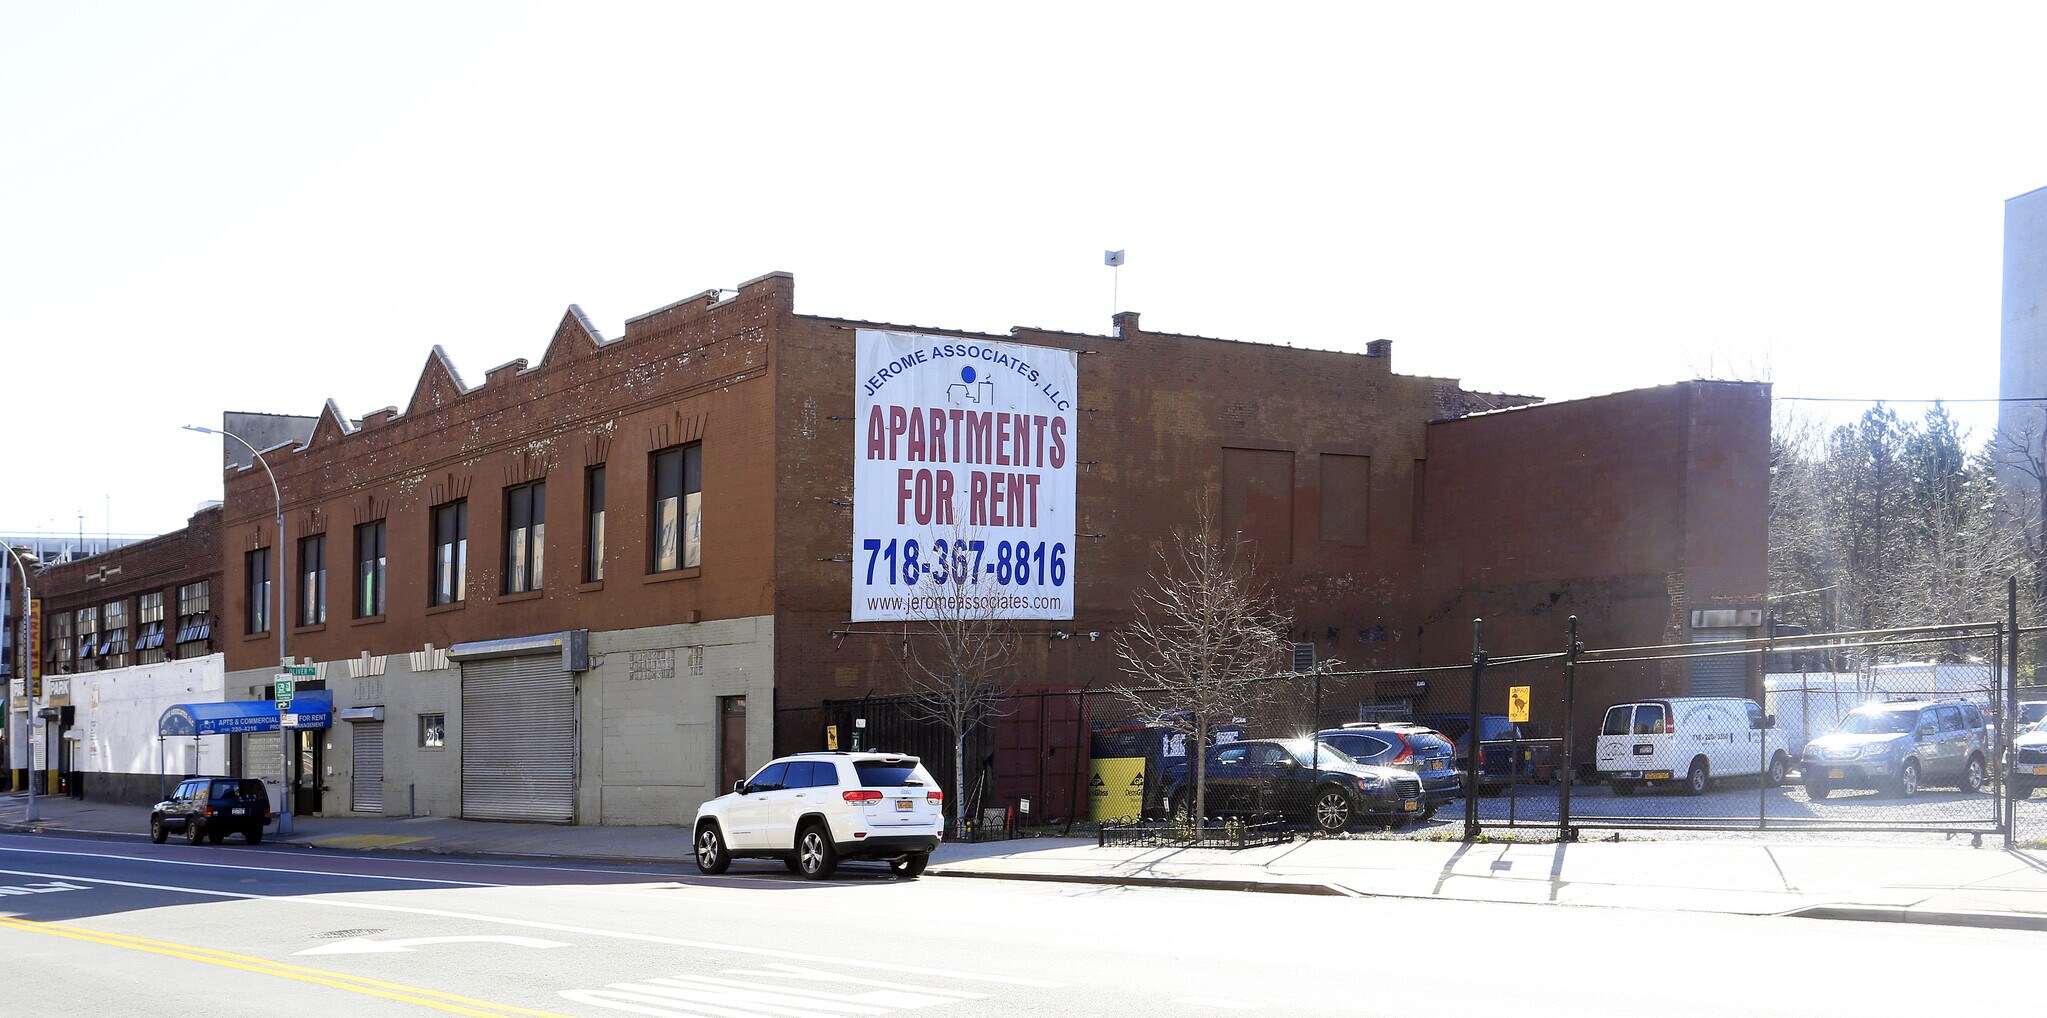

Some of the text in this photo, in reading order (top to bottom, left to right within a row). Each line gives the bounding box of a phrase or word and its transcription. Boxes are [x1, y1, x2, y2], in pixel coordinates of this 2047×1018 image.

[864, 345, 1070, 412] JEROME ASSOCIATES, LLC
[867, 404, 1067, 469] APARTMENTS
[897, 468, 1041, 528] FOR RENT
[863, 538, 1066, 587] 718-367-8816
[867, 594, 1062, 615] www.jeromeassociates.com
[240, 716, 279, 725] COMMERCIAL
[311, 713, 327, 721] RENT
